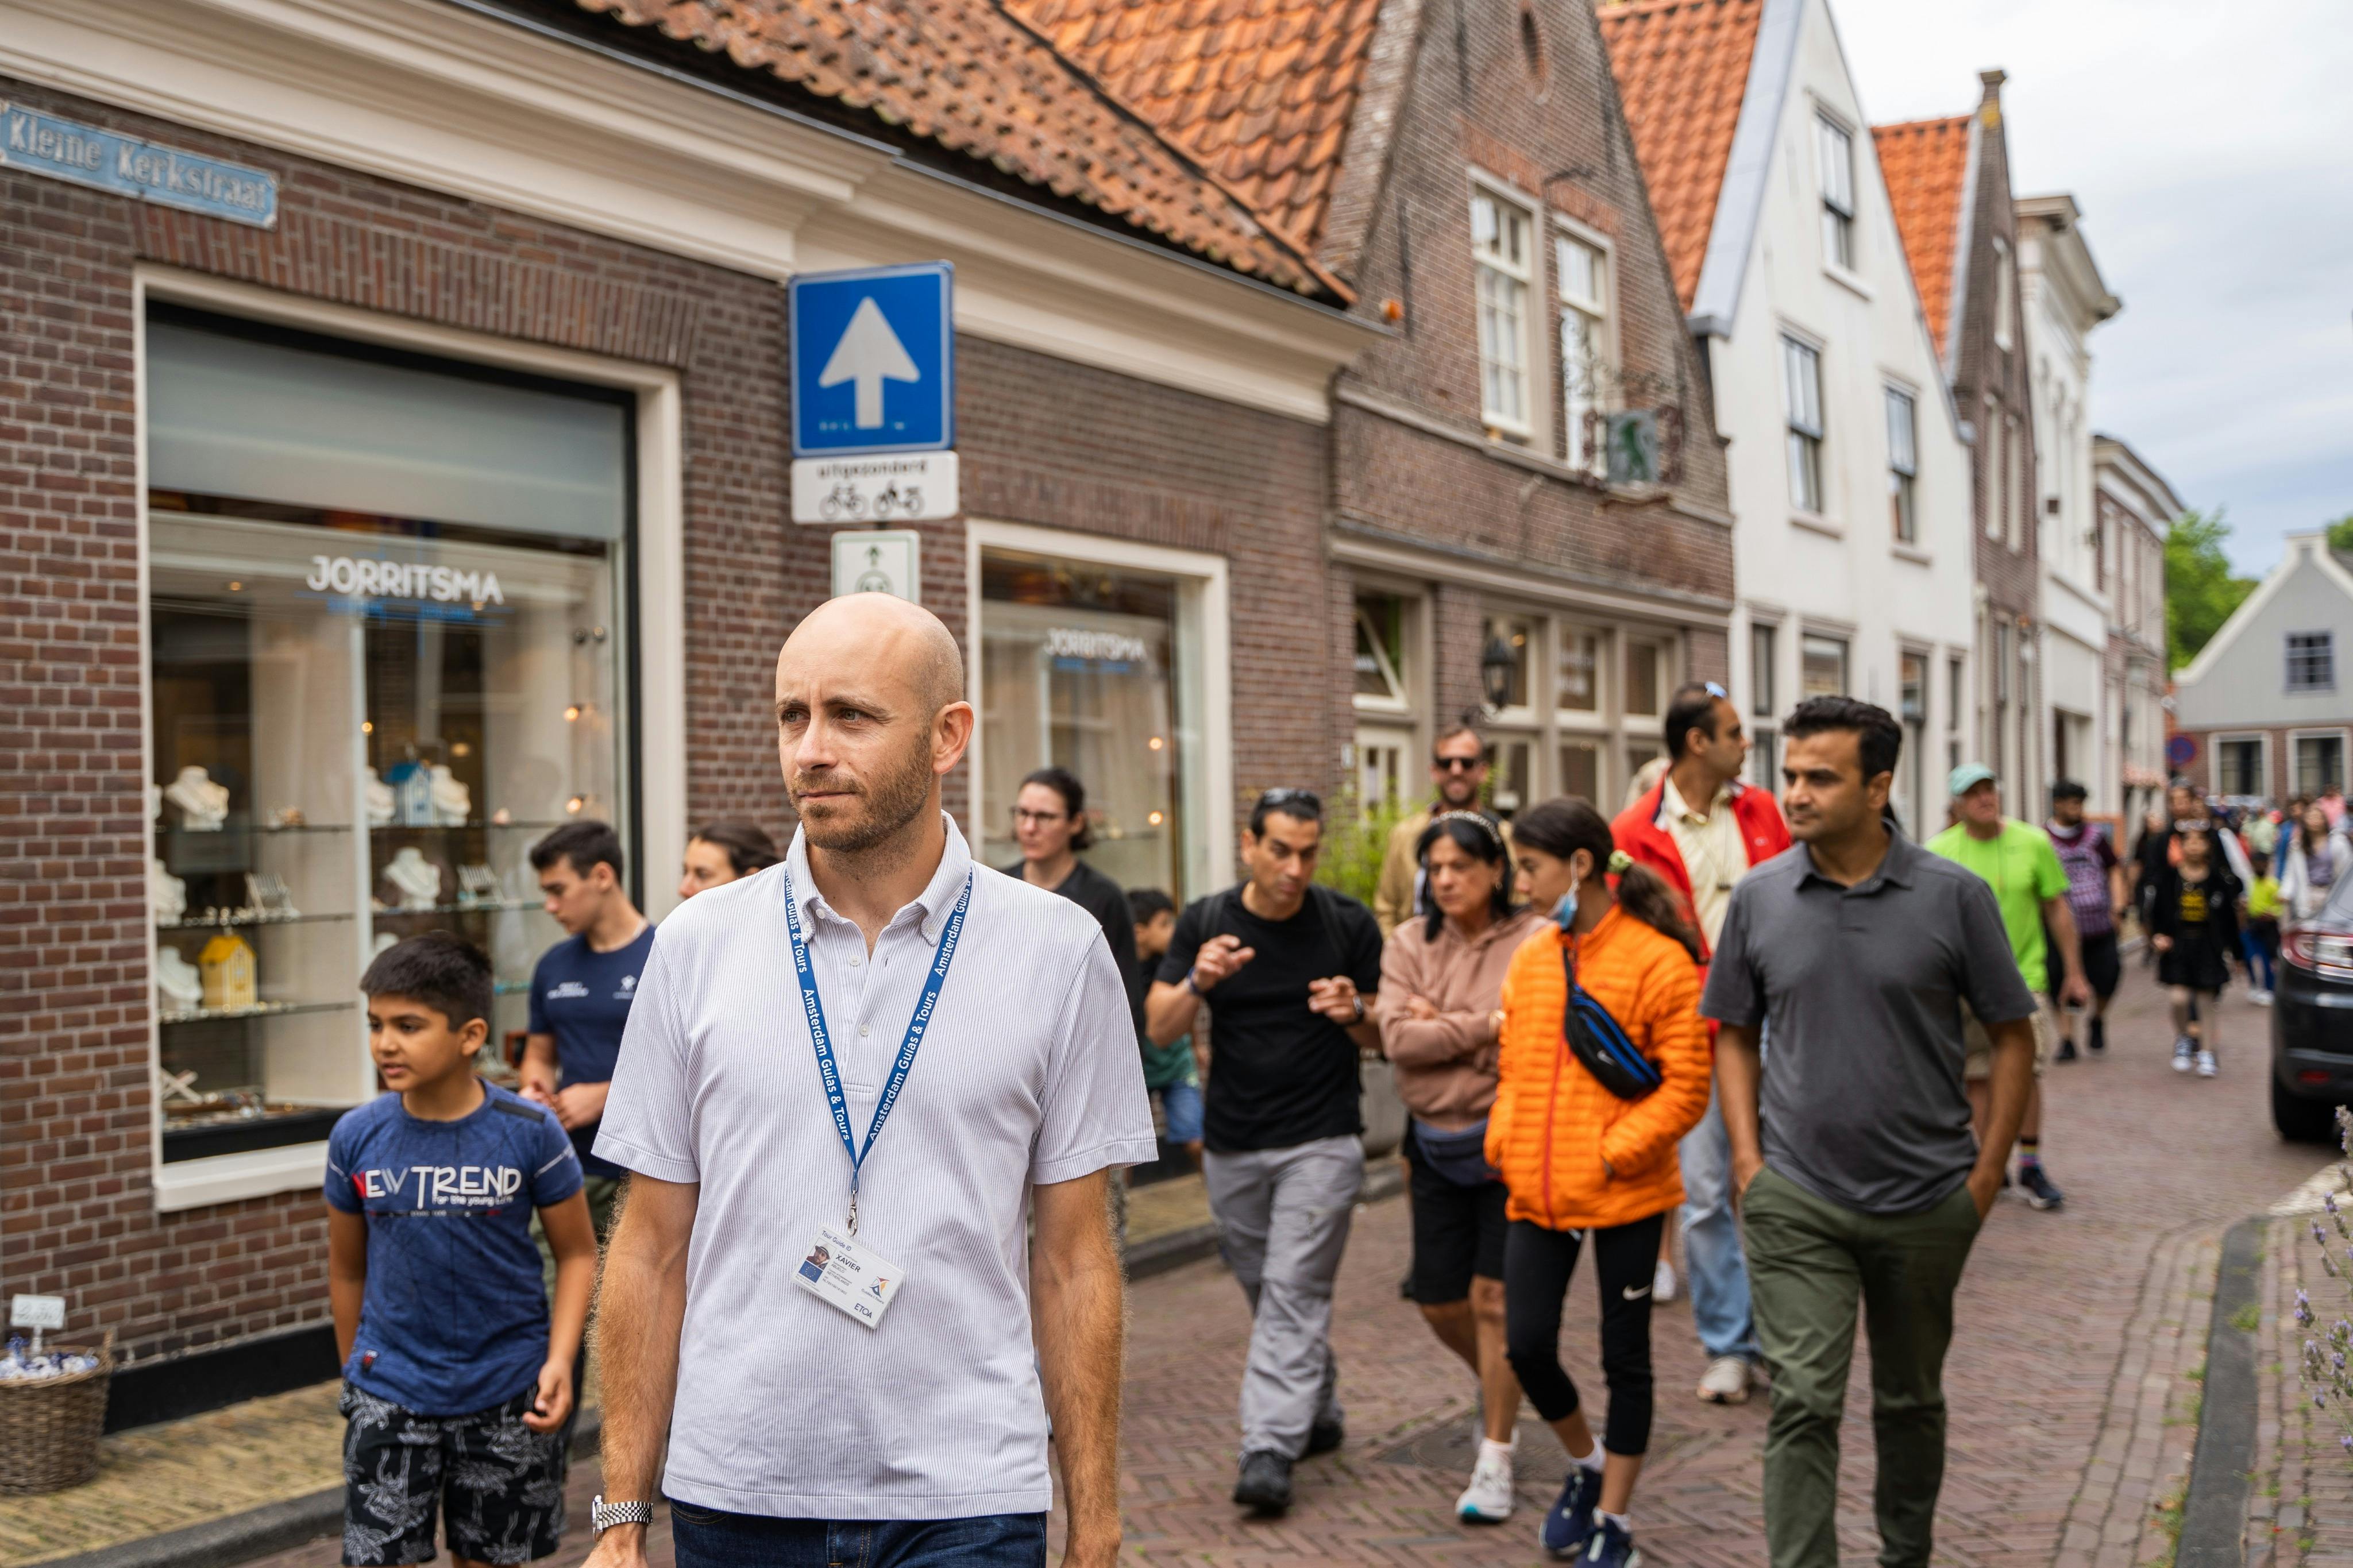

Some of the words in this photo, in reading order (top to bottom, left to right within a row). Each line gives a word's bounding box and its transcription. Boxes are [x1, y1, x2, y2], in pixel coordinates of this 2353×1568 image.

[9, 113, 102, 171] Kleine
[117, 140, 268, 213] Kerkstraat
[306, 554, 505, 605] JORRITSMA
[1043, 627, 1147, 661] JORRITSMA
[792, 932, 803, 940] &
[934, 916, 963, 977] Amsterdam
[794, 943, 807, 973] Tours
[804, 989, 827, 1056] Amsterdam
[915, 991, 936, 1021] Tours
[912, 1026, 923, 1034] &
[898, 1036, 919, 1069] Guías
[821, 1059, 837, 1092] Guías
[831, 1095, 842, 1104] &
[870, 1072, 905, 1141] Amsterdam
[834, 1107, 850, 1140] Tours
[411, 1165, 522, 1210] TREND
[821, 1230, 832, 1240] Tour
[832, 1237, 846, 1248] Guide
[836, 1254, 861, 1272] XAVIER
[854, 1303, 873, 1319] ETOA
